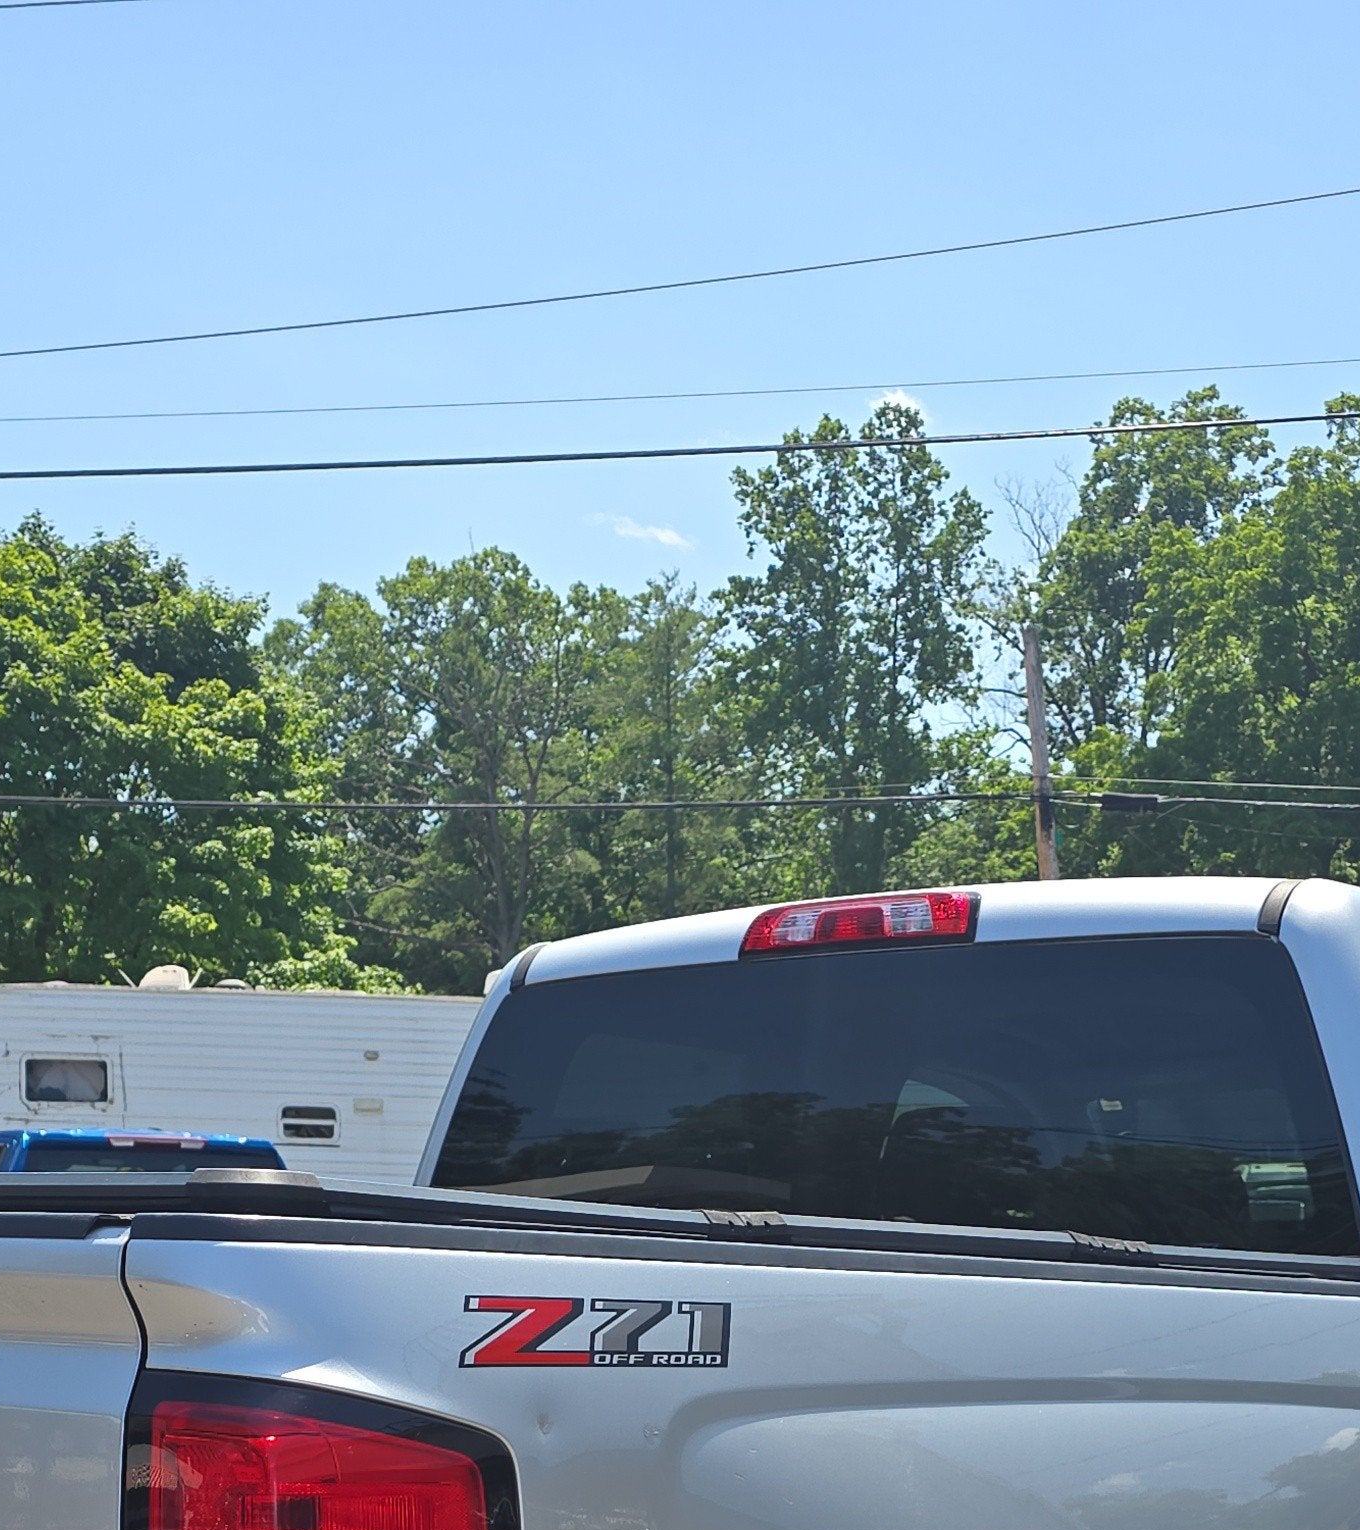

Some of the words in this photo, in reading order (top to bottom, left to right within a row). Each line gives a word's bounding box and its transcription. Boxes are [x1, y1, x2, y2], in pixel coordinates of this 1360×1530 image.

[458, 1294, 733, 1368] Z71
[593, 1353, 645, 1367] OFF
[651, 1353, 723, 1367] ROAD
